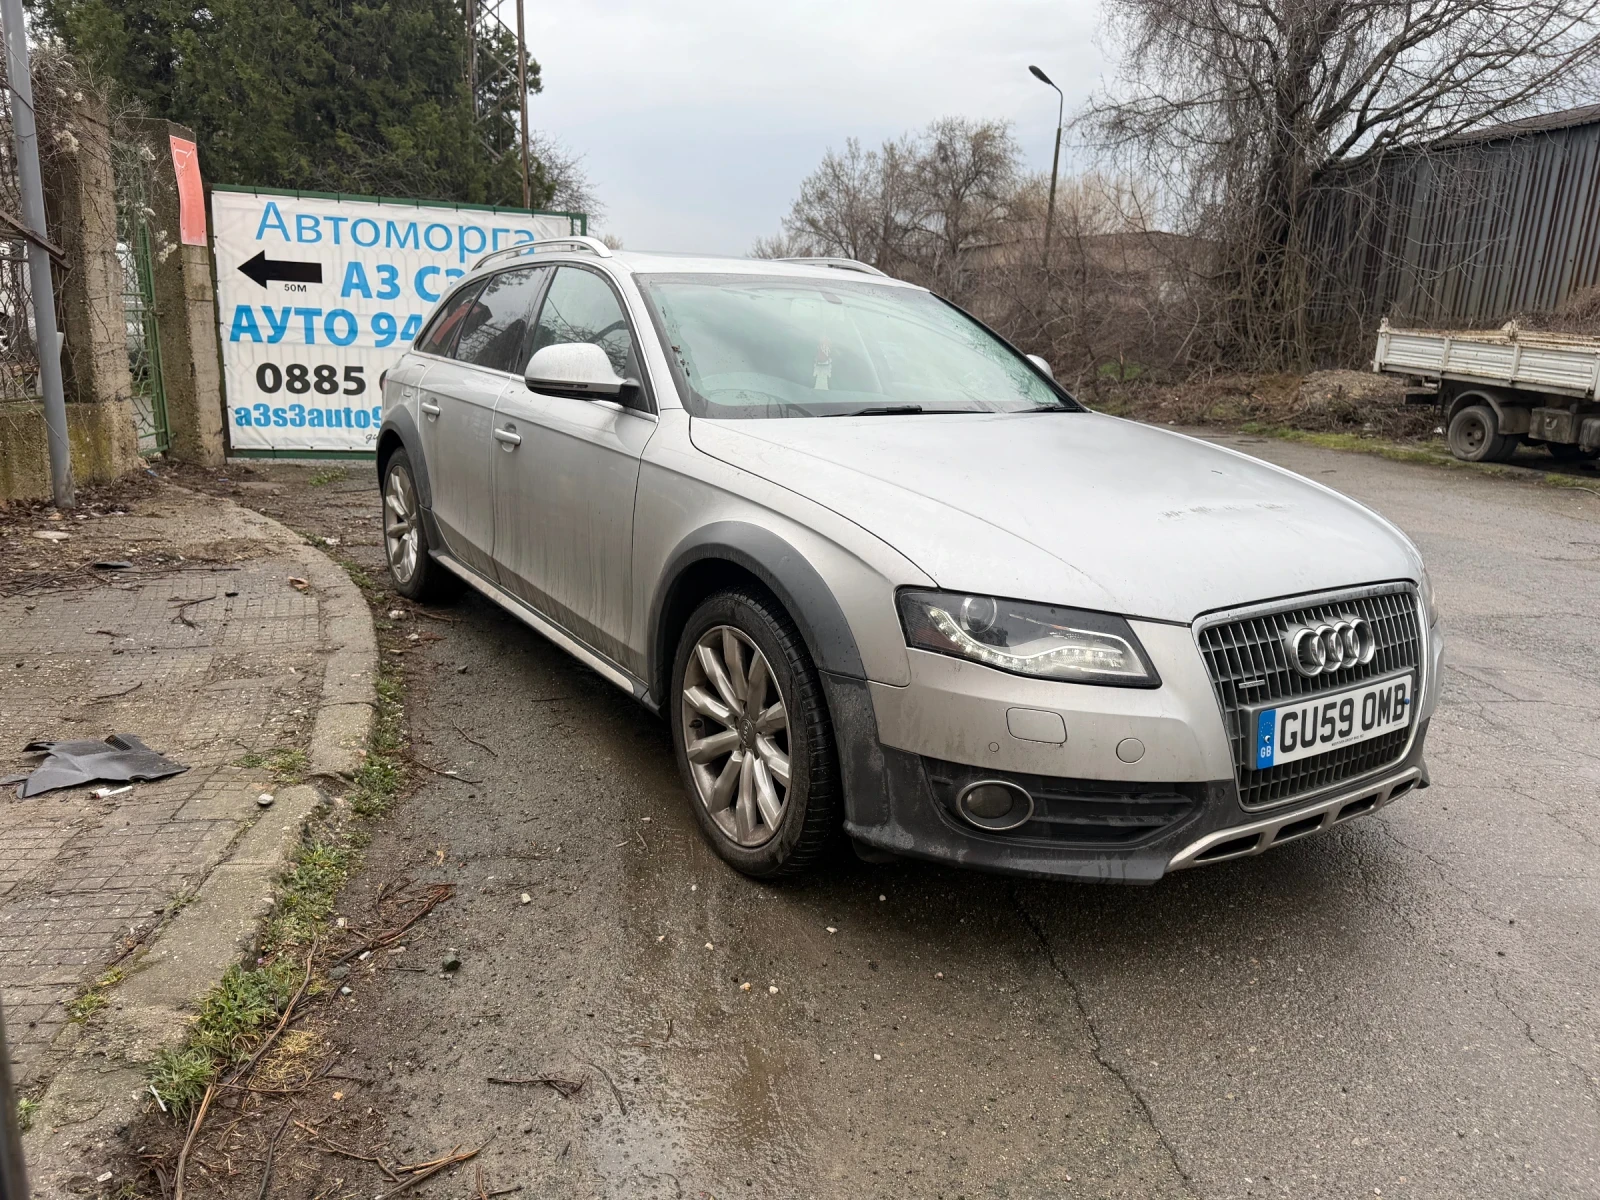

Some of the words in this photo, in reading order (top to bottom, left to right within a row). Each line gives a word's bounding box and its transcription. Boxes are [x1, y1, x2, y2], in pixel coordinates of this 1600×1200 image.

[255, 201, 535, 264] Автоморга
[229, 304, 359, 347] АУТО
[370, 311, 423, 348] 94
[255, 362, 367, 396] 0885
[234, 402, 382, 429] a3s3auto9
[1279, 697, 1355, 753] GU59
[1361, 682, 1406, 732] OMB
[1260, 745, 1272, 758] GB
